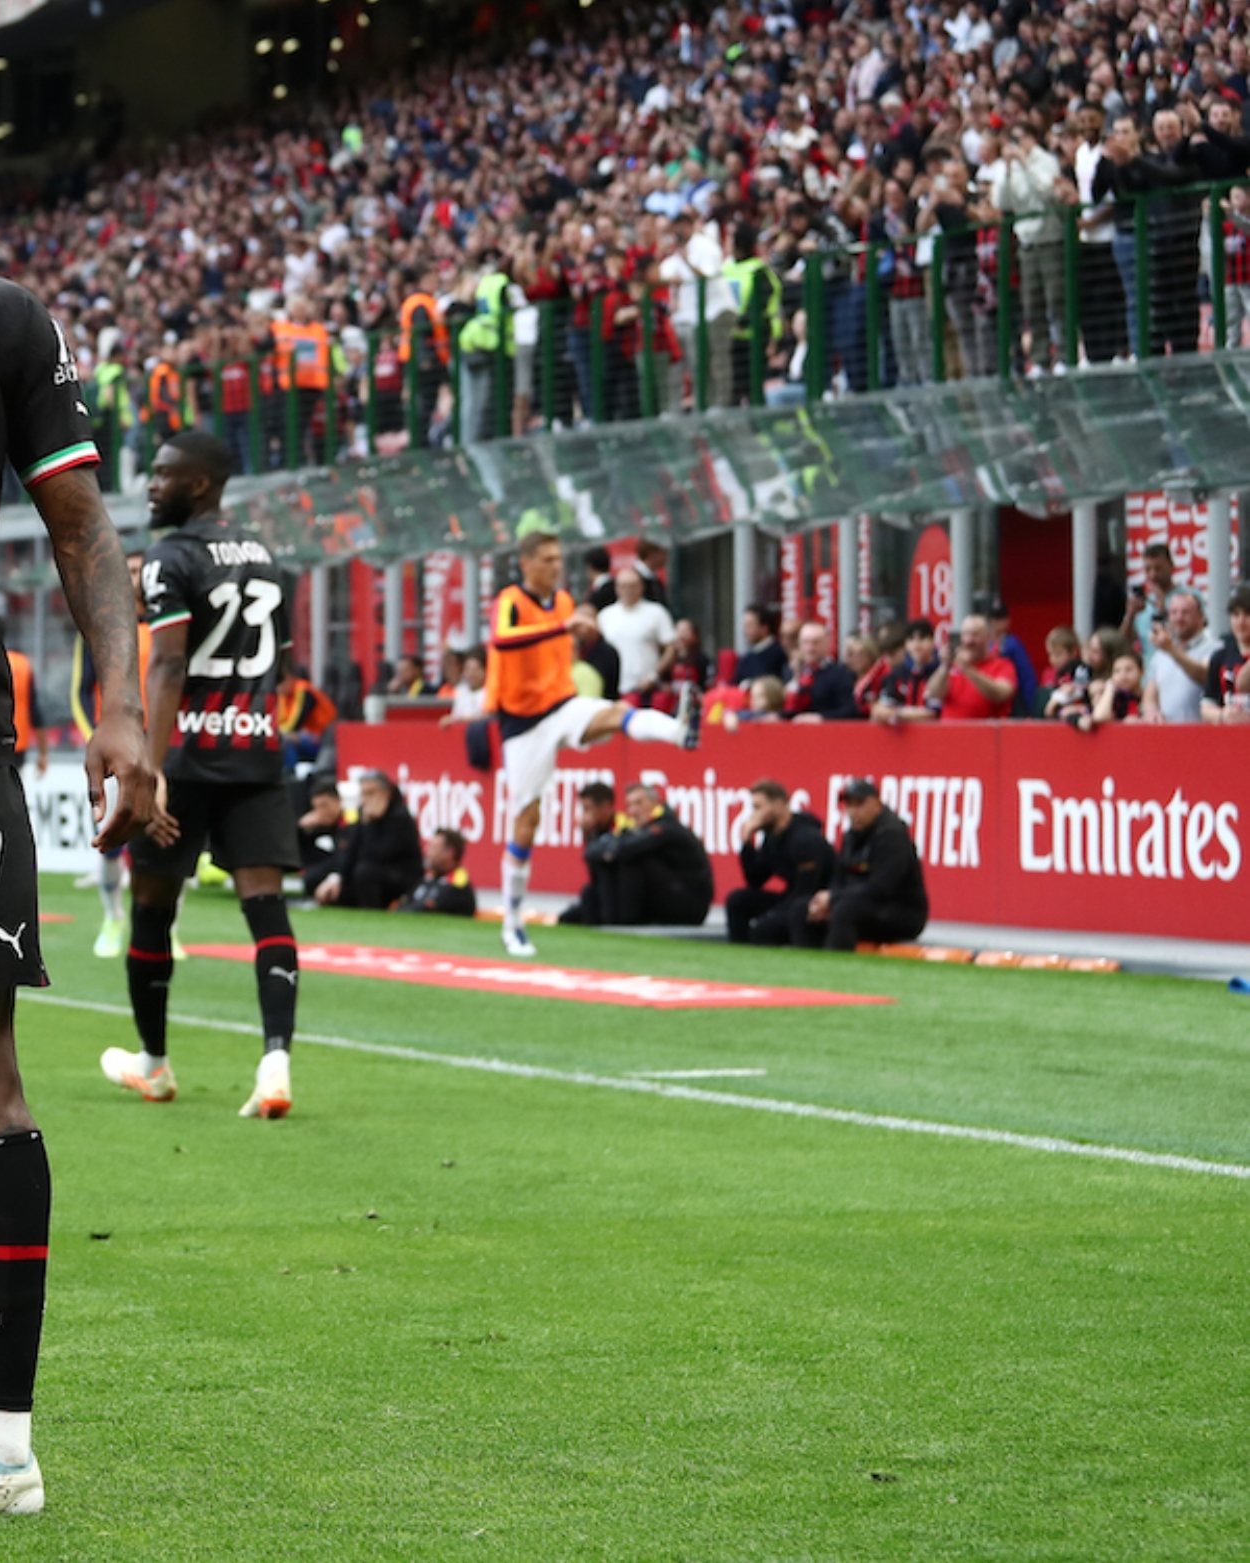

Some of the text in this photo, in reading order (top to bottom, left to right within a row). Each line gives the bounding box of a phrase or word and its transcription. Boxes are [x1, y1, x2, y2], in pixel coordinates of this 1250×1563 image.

[915, 561, 953, 617] 18
[188, 578, 282, 679] 23
[177, 706, 273, 737] wefox
[1017, 776, 1242, 881] Emirates
